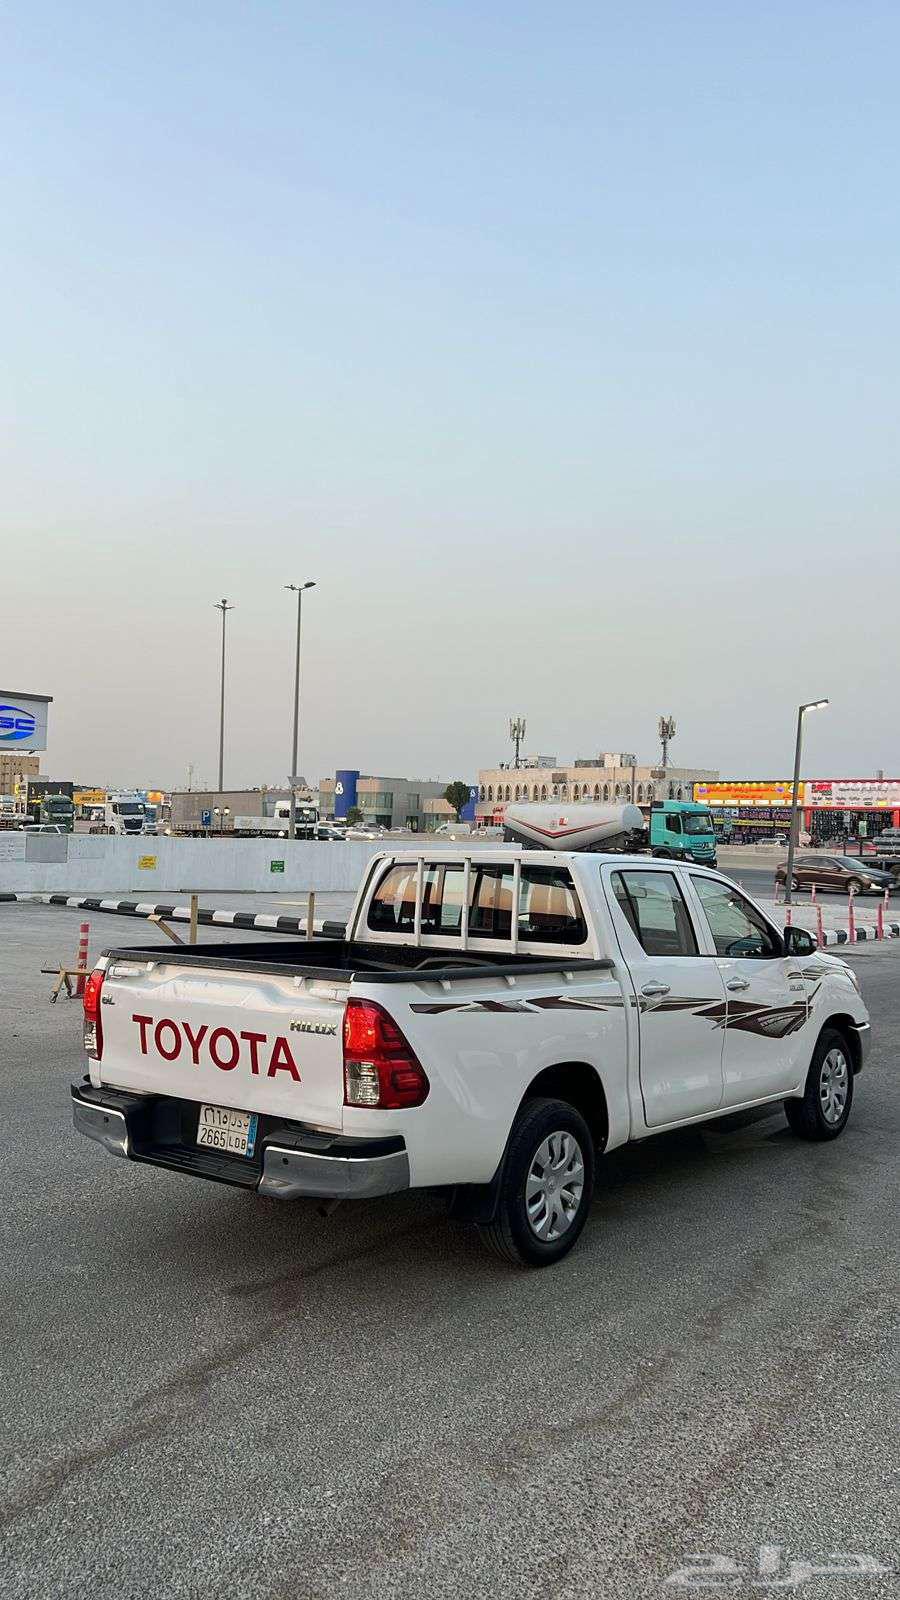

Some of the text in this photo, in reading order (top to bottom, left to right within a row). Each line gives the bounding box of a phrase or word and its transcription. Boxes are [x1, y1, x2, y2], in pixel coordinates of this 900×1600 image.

[289, 1018, 337, 1036] HILUX
[132, 1014, 302, 1082] TOYOTA
[201, 1128, 226, 1147] 2665
